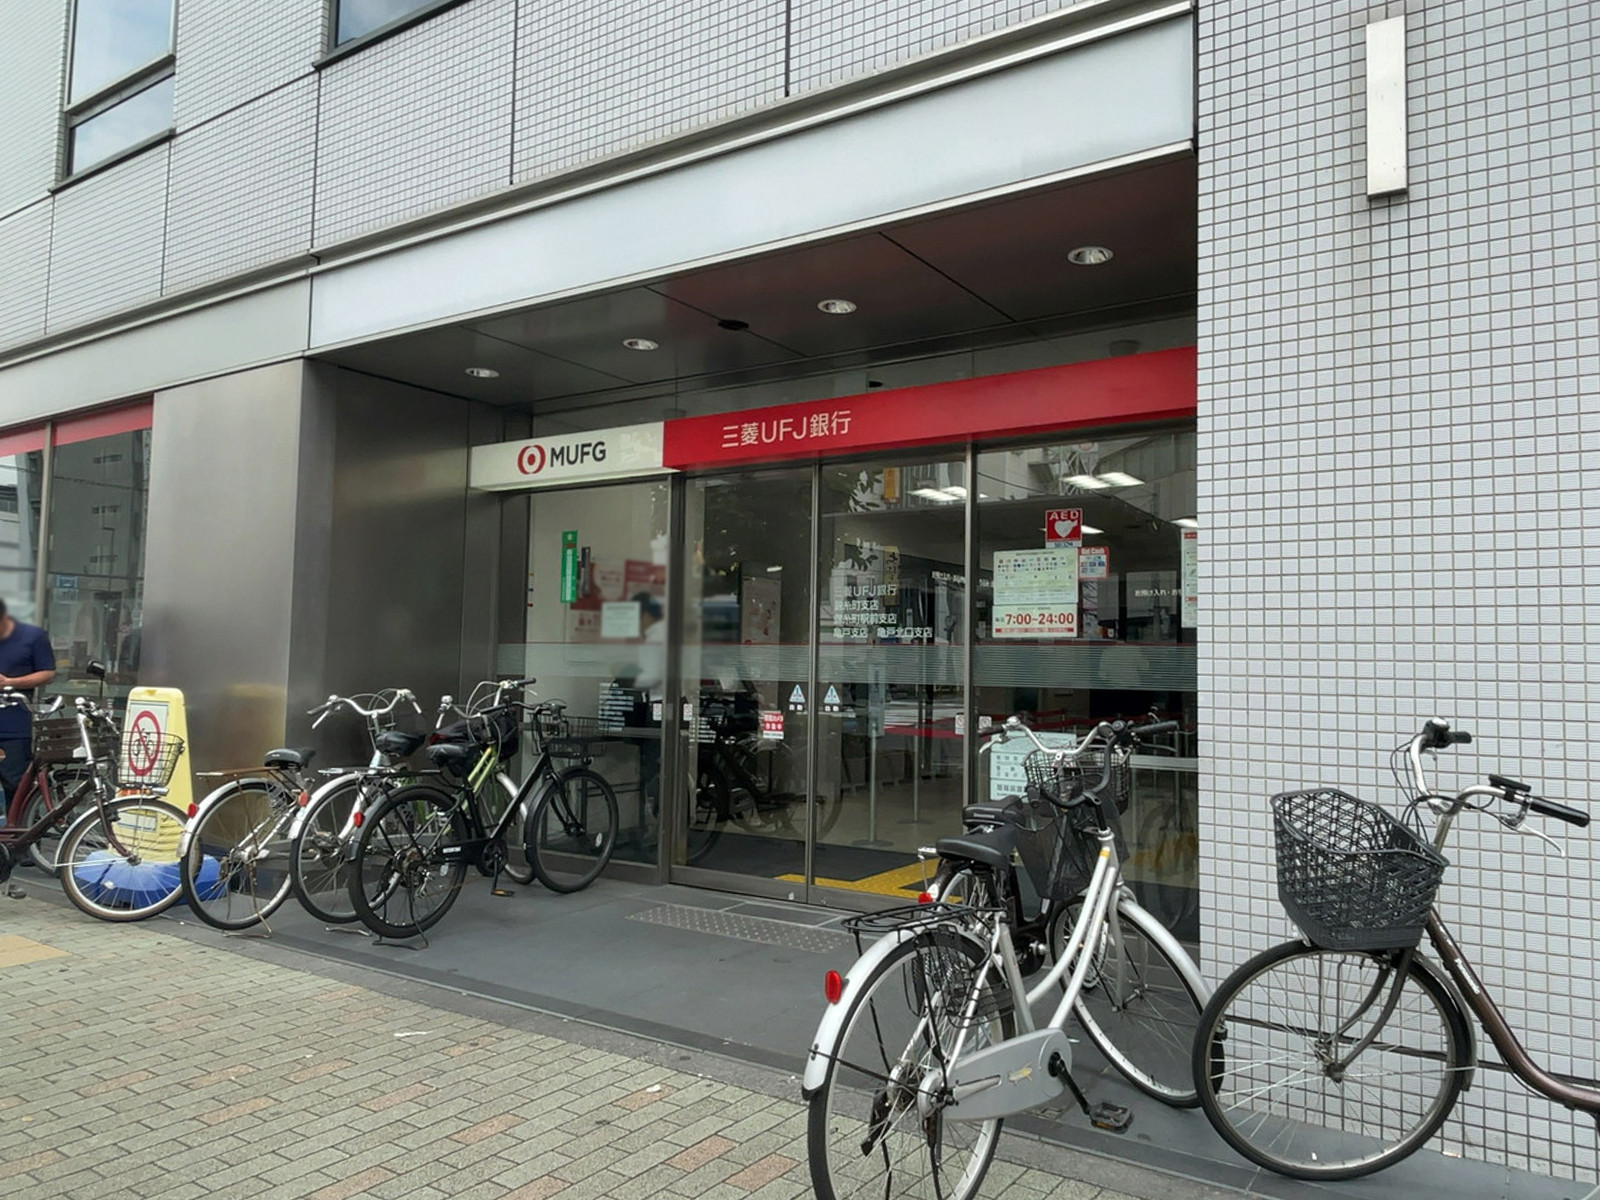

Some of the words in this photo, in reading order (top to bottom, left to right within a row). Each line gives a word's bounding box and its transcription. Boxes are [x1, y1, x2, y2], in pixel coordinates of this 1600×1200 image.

[721, 410, 852, 449] 三菱UFJ銀行
[549, 441, 607, 468] MUFG
[1049, 510, 1079, 520] AED
